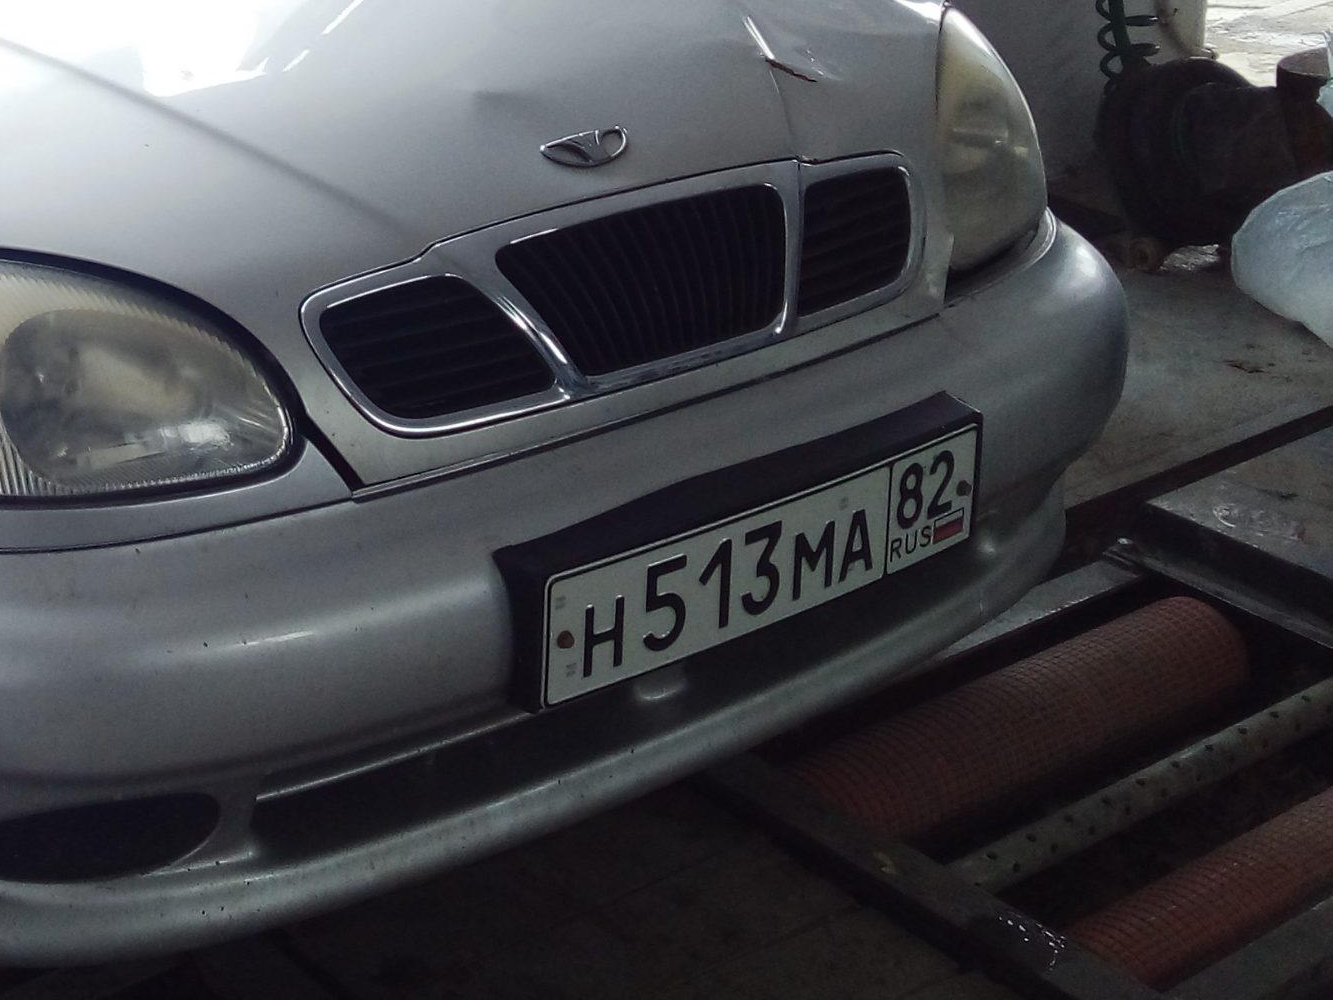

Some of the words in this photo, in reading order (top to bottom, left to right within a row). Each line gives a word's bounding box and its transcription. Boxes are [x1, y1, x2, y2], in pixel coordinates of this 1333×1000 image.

[582, 508, 873, 678] Н513МА
[896, 450, 955, 528] 82
[890, 528, 933, 562] RUS
